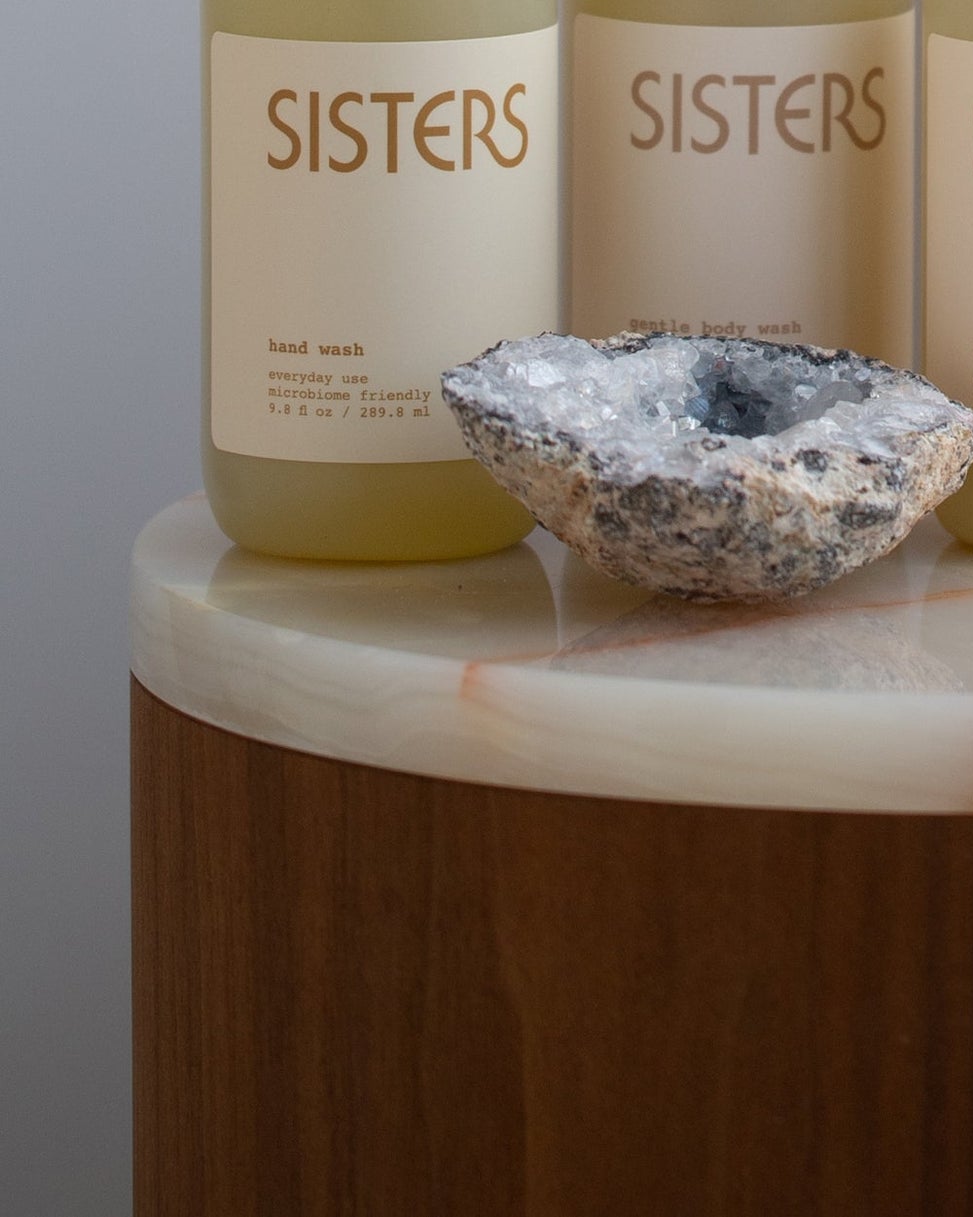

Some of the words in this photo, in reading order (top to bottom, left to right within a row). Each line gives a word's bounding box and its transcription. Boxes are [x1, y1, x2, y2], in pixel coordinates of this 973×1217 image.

[630, 67, 887, 155] SISTERS
[267, 83, 529, 174] SISTERS
[629, 318, 690, 334] gentle
[701, 321, 747, 336] body
[757, 321, 803, 334] wash
[268, 338, 309, 355] hand
[319, 343, 365, 357] wash
[268, 370, 334, 385] everyday
[342, 376, 369, 384] use
[268, 387, 351, 401] microbiome
[360, 389, 432, 403] friendly
[268, 403, 291, 415] 9.8
[299, 404, 308, 416] fl
[315, 409, 333, 417] oz
[342, 406, 350, 419] /
[360, 407, 404, 418] 289.8
[413, 406, 430, 417] ml
